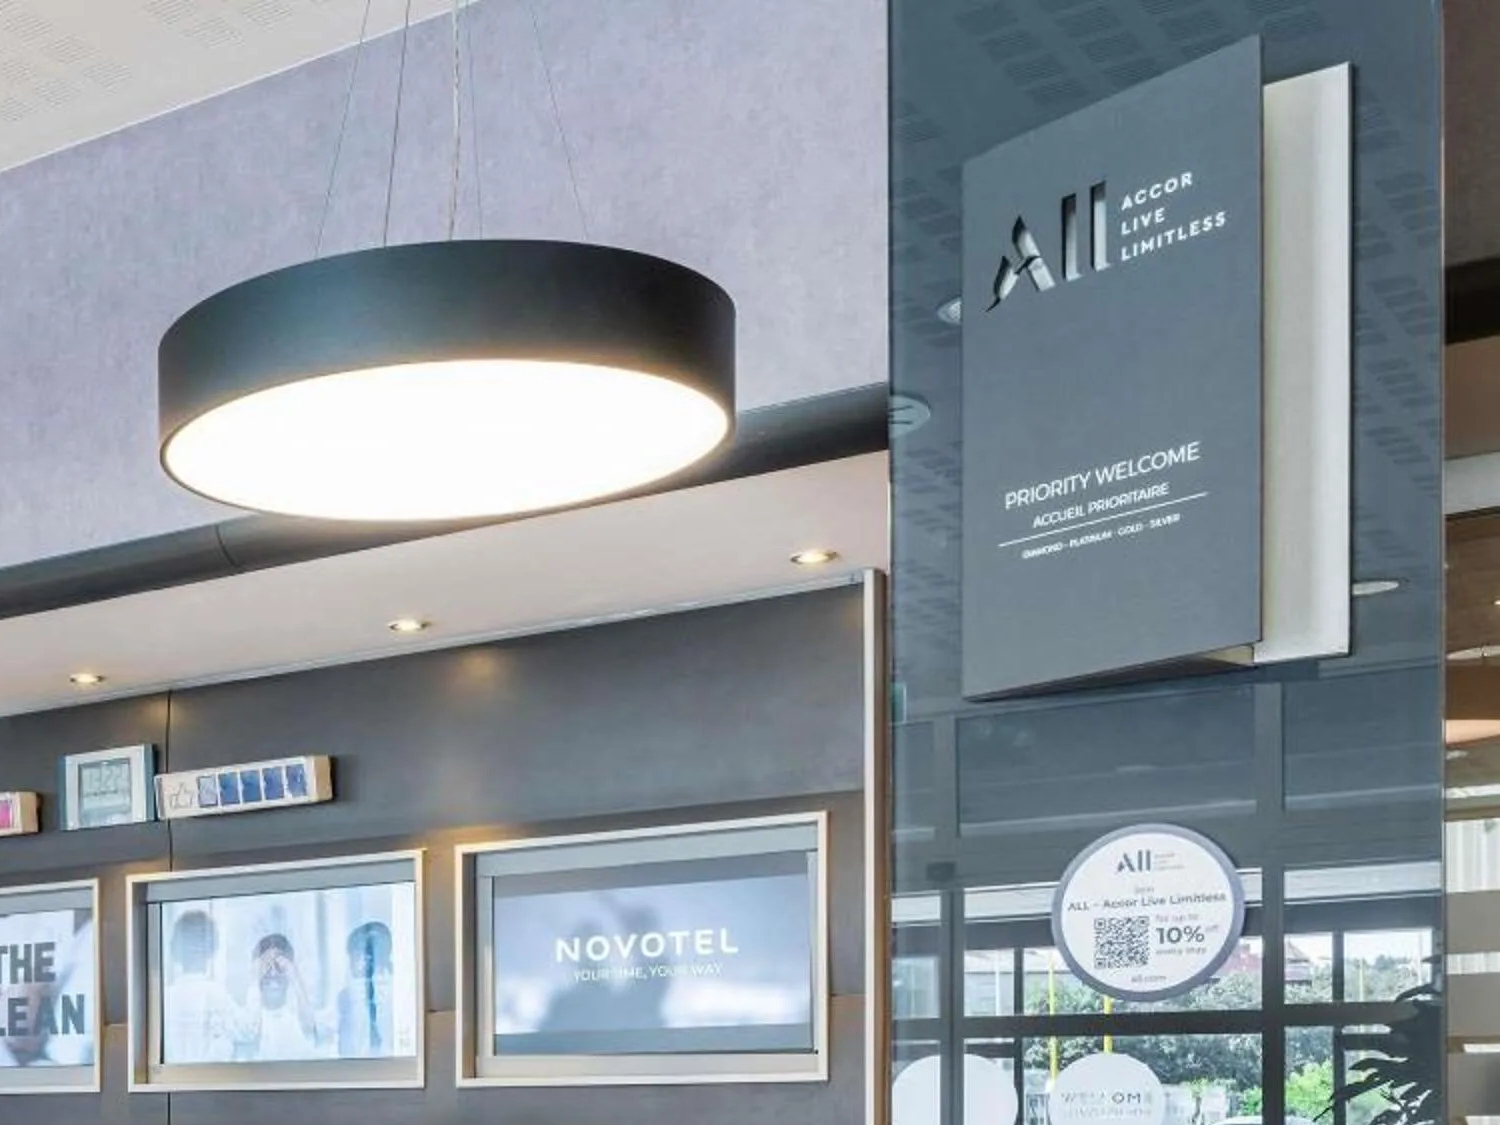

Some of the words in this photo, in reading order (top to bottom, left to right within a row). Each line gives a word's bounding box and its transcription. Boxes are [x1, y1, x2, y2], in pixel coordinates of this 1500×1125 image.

[1121, 171, 1193, 211] ACCOR
[1121, 208, 1165, 236] LIVE
[1121, 211, 1227, 261] LIMITLESS
[1005, 472, 1091, 510] PRIORITY
[1095, 441, 1200, 484] WELCOME
[1032, 504, 1085, 528] ACCUEIL
[1088, 481, 1170, 514] PRIORITAIRE
[1141, 896, 1166, 907] Live
[556, 928, 739, 962] NOVOTEL
[1156, 925, 1205, 944] 10%
